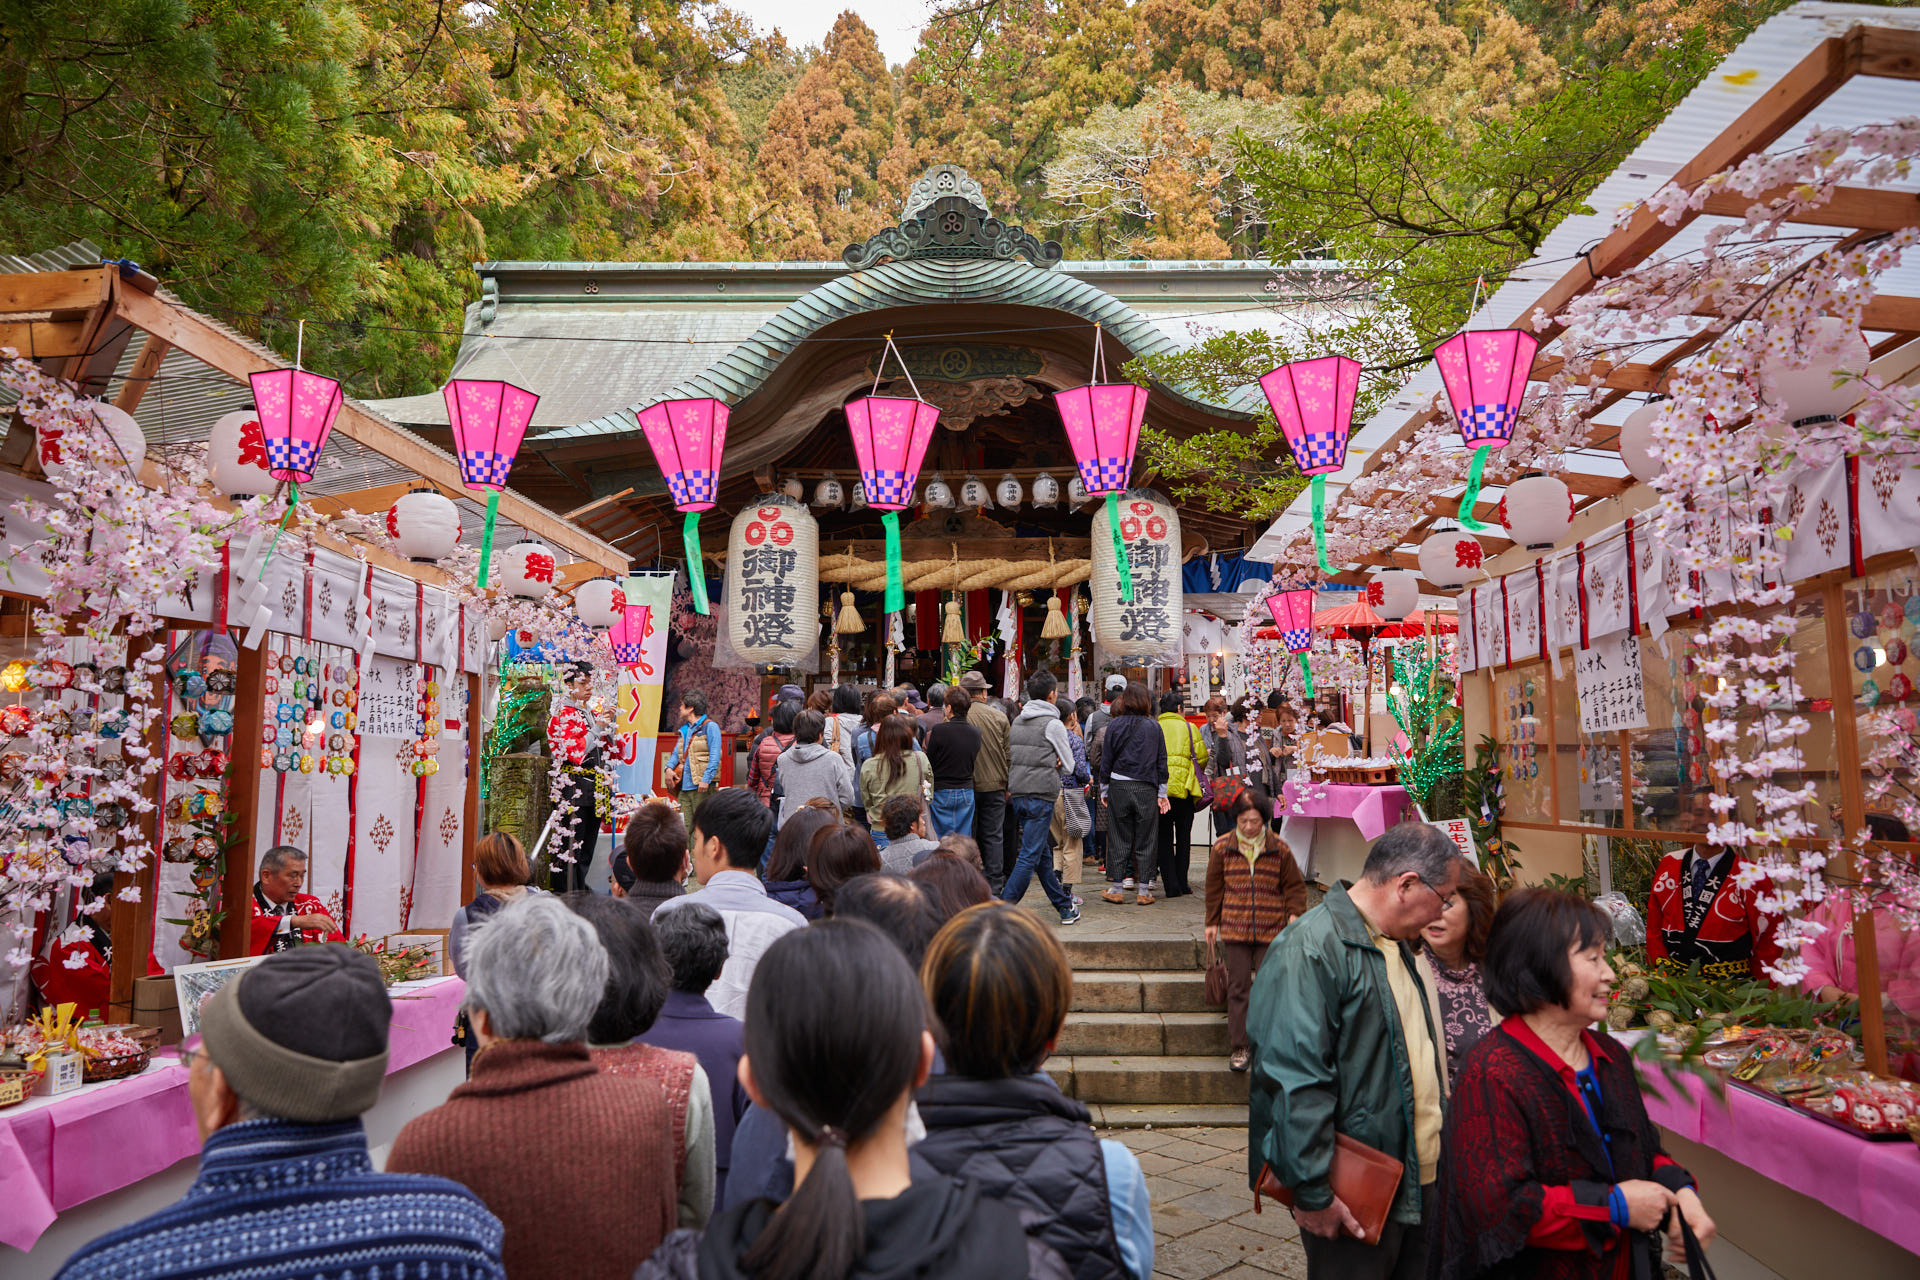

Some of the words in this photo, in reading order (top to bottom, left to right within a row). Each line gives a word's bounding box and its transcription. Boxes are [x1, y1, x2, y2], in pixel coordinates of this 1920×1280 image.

[524, 552, 556, 584] 祭
[1455, 540, 1484, 569] 祭
[740, 544, 798, 649] 御神燈
[1116, 538, 1170, 642] 御神燈
[519, 630, 532, 644] 祭
[375, 669, 382, 683] 大
[1578, 661, 1586, 674] 小
[1587, 657, 1593, 672] 中
[1596, 653, 1606, 670] 大
[1609, 682, 1618, 724] 二千円
[1689, 876, 1721, 929] 大国さま
